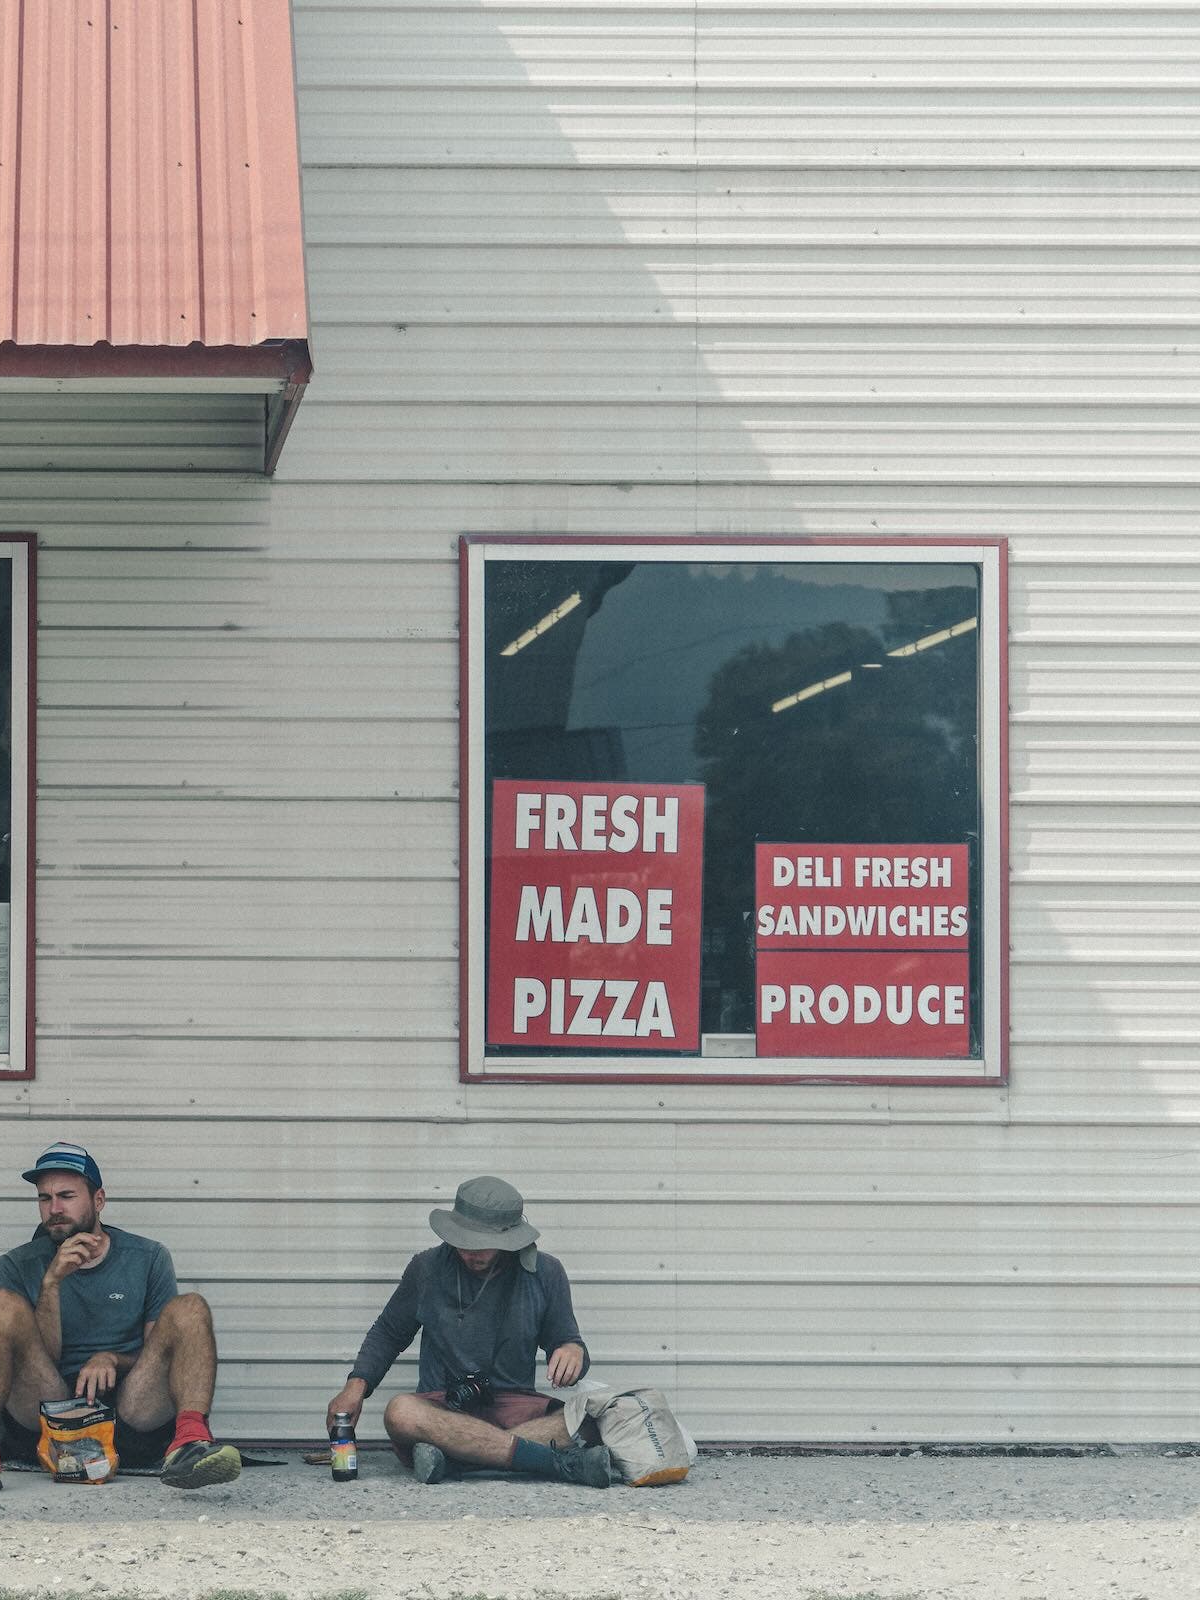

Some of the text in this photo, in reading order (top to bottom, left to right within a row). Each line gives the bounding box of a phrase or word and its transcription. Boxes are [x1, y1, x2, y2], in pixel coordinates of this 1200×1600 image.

[515, 793, 679, 853] FRESH
[773, 856, 952, 888] DELI FRESH
[515, 885, 673, 945] MADE
[756, 904, 968, 937] SANDWICHES
[513, 977, 676, 1038] PIZZA
[761, 984, 965, 1025] PRODUCE
[645, 1421, 666, 1459] SUMMIT
